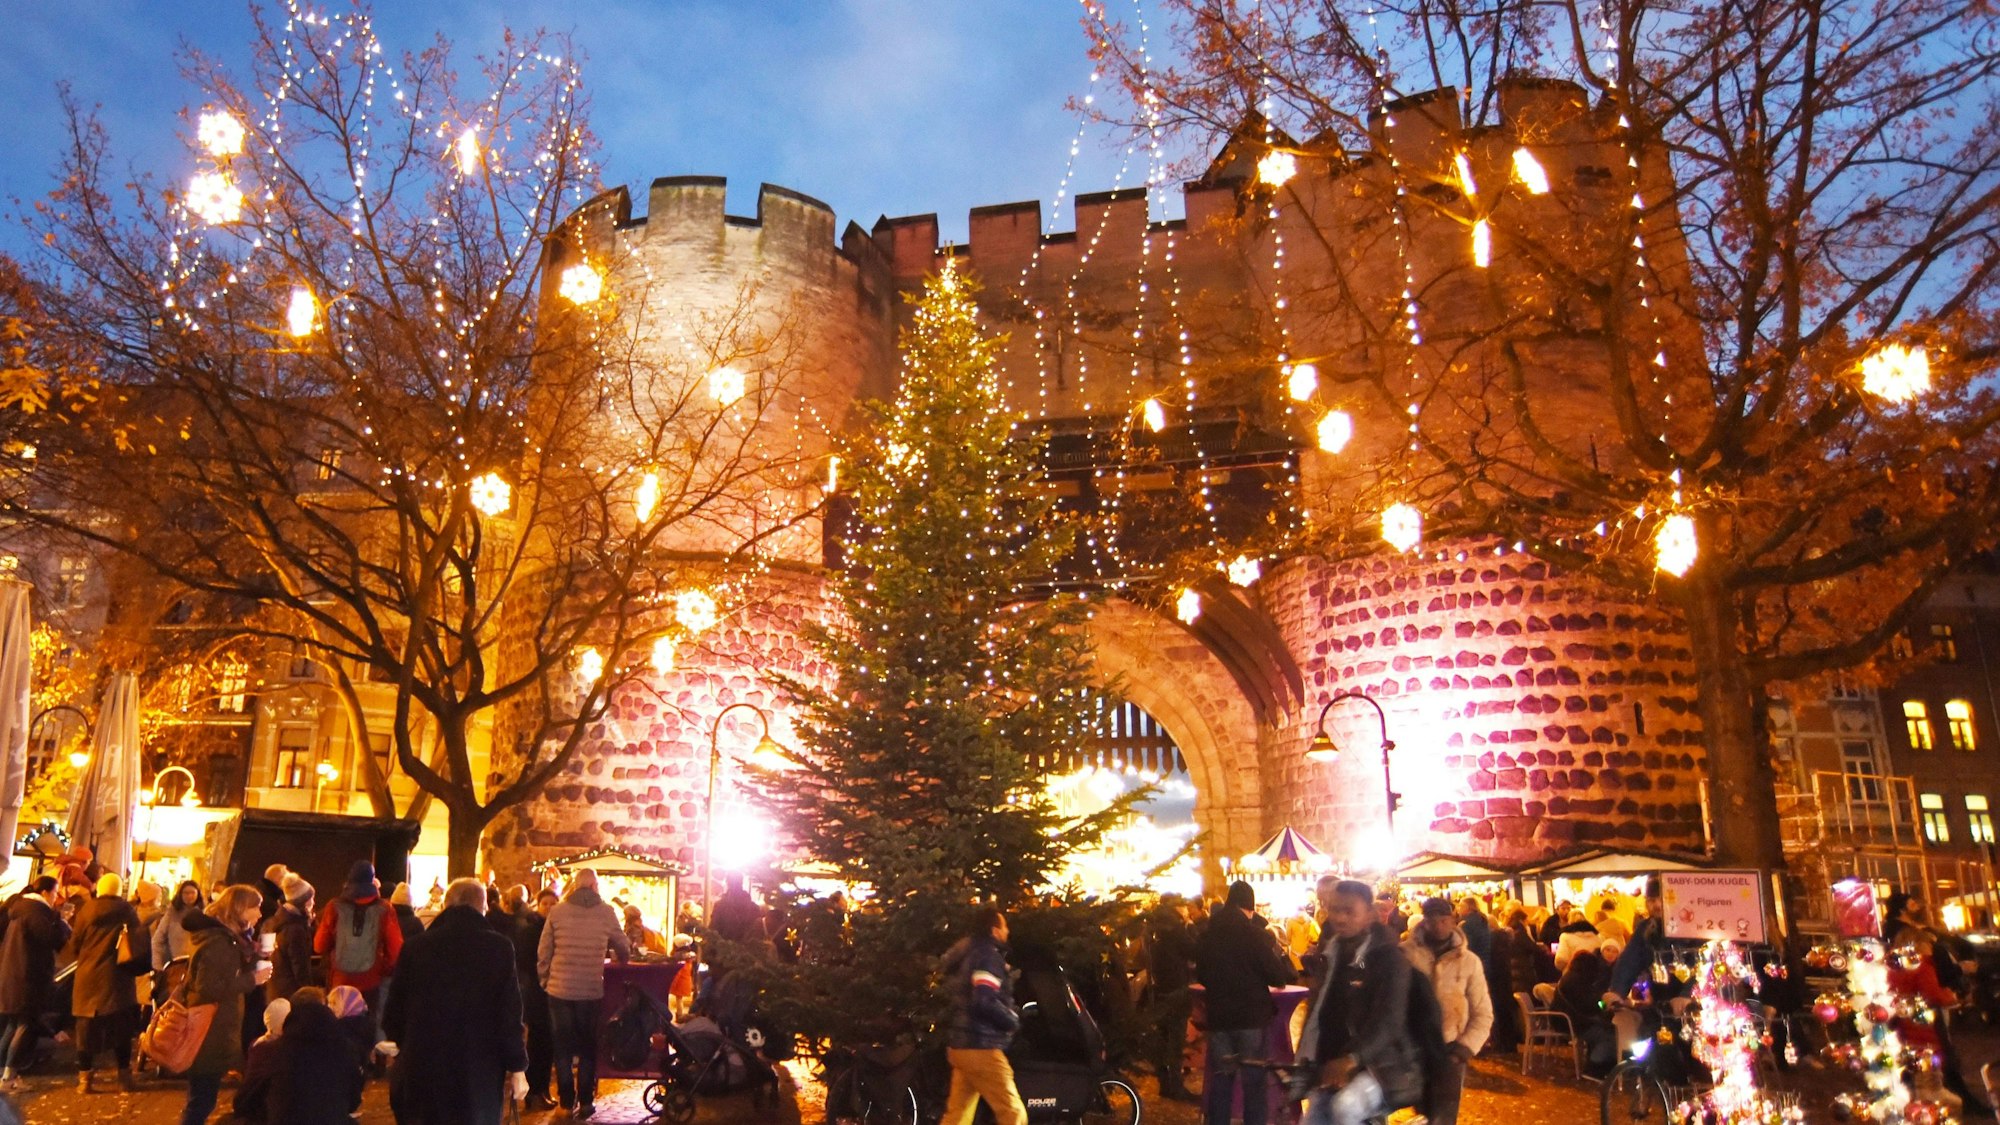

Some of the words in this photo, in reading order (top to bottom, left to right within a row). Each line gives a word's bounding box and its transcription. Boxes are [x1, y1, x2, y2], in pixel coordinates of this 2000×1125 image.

[1718, 877, 1750, 886] KUGEL
[1697, 898, 1732, 906] Figuren
[1706, 919, 1714, 930] 2
[1718, 919, 1726, 931] €
